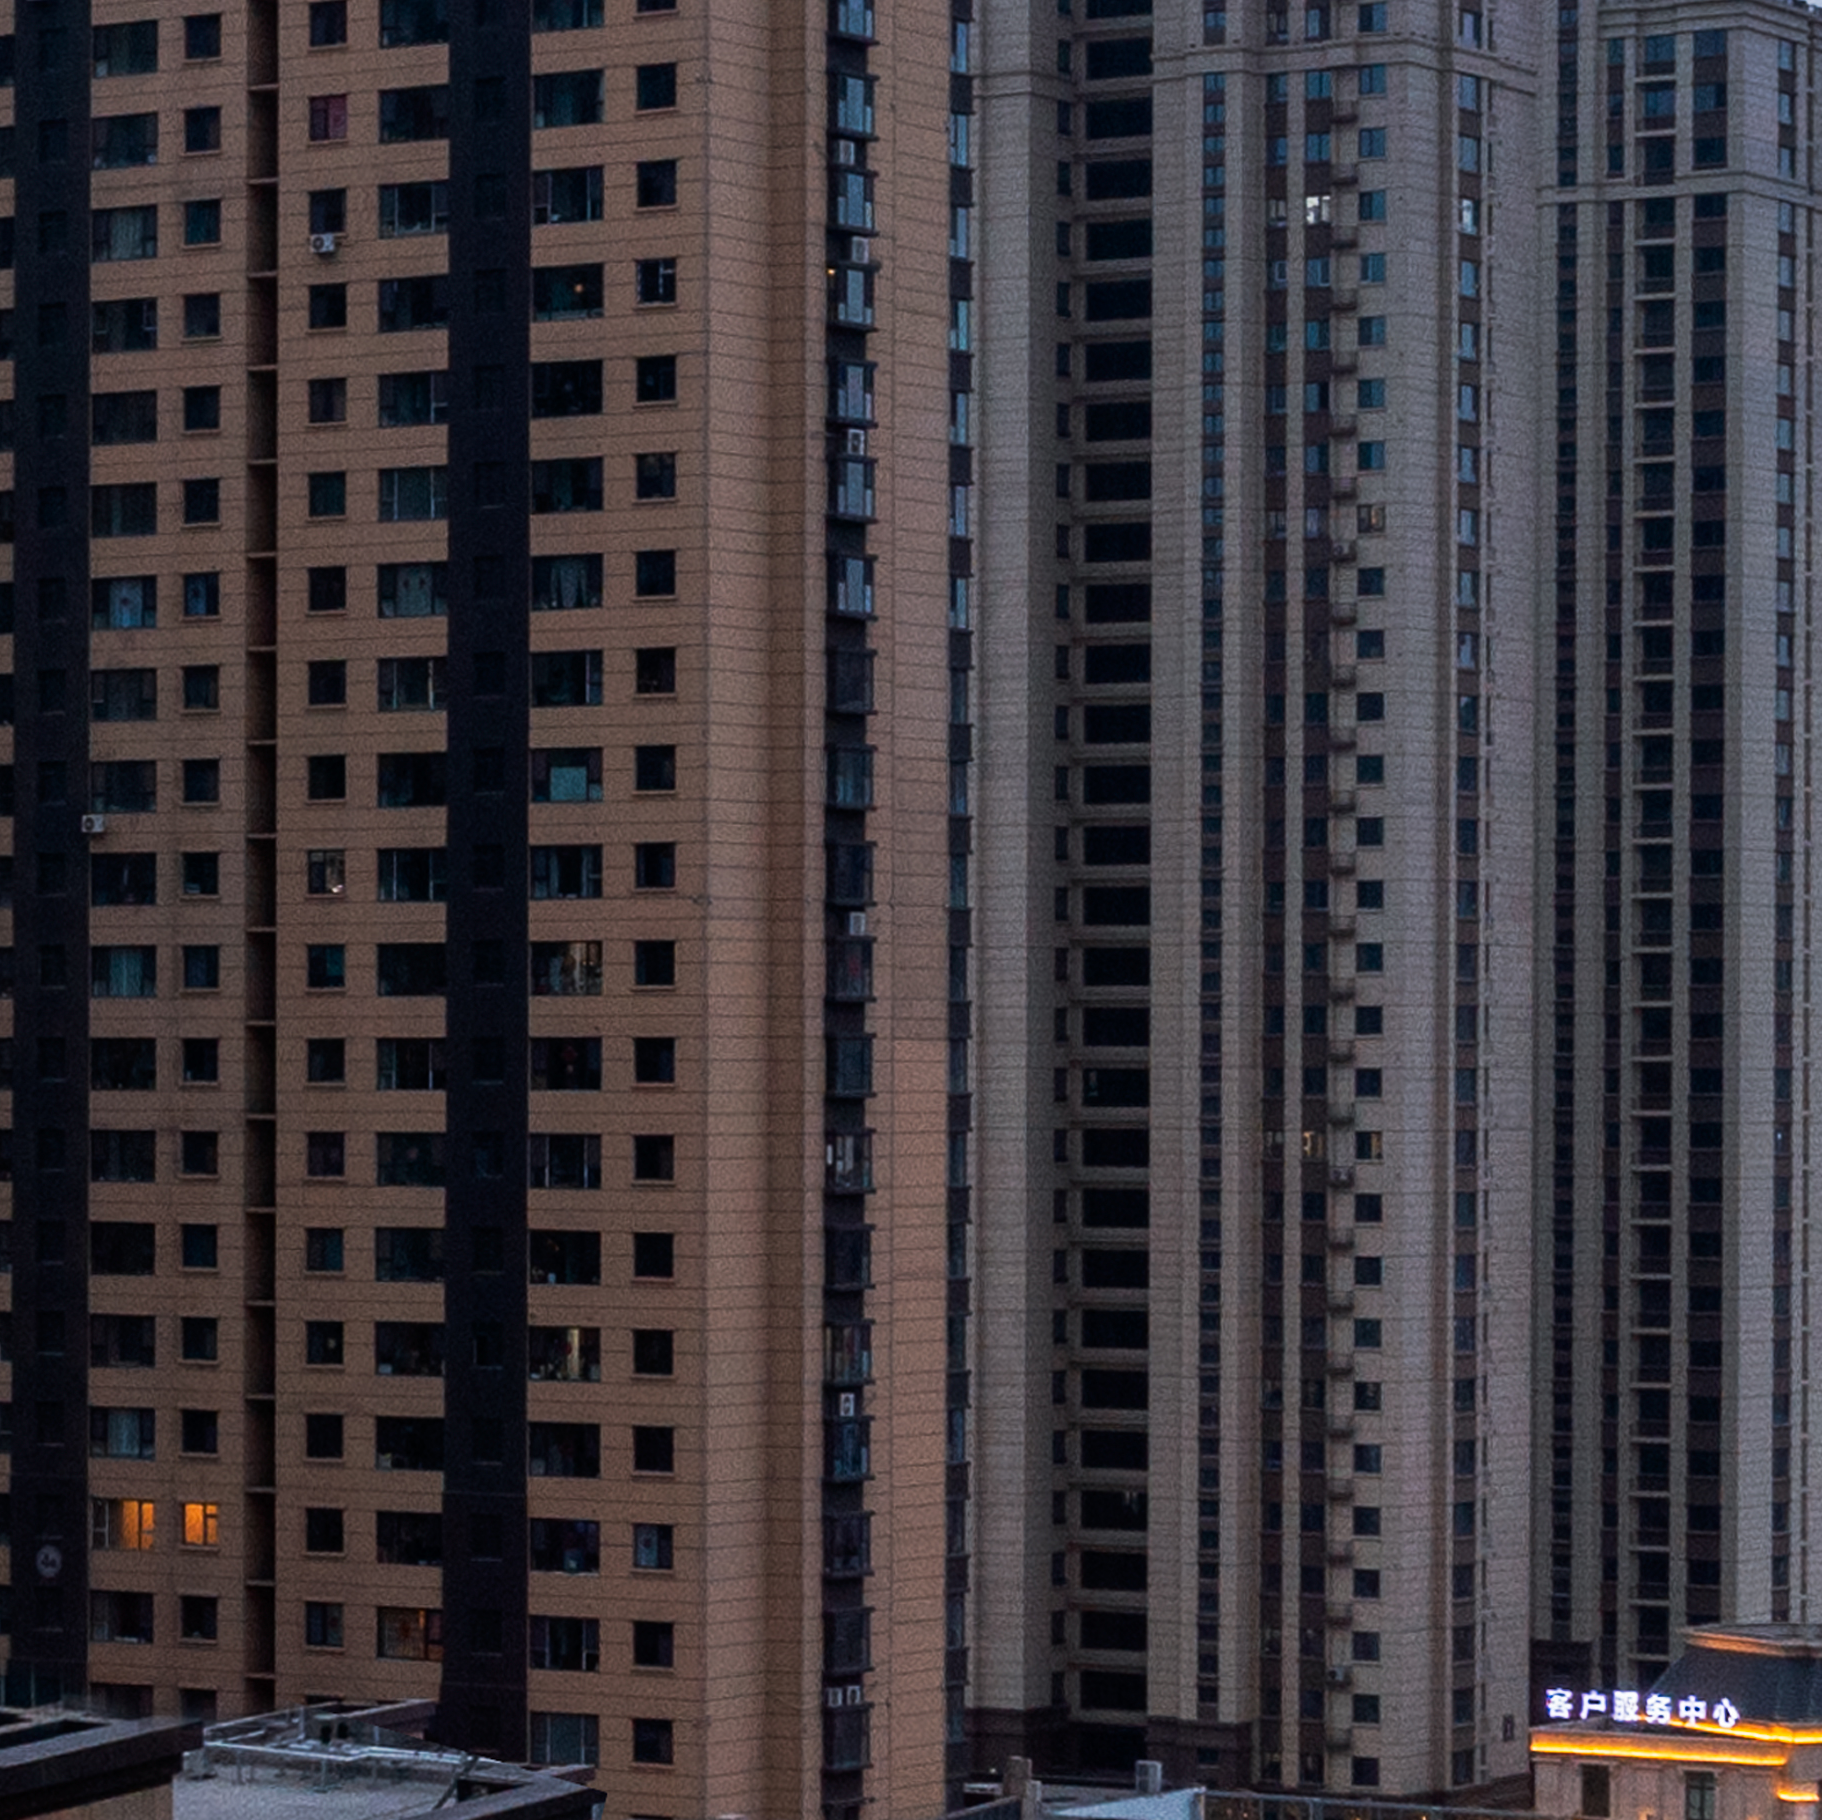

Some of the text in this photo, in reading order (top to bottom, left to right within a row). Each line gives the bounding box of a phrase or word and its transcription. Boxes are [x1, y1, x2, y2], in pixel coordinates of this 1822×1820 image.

[1546, 1688, 1740, 1729] 客户服务中心
